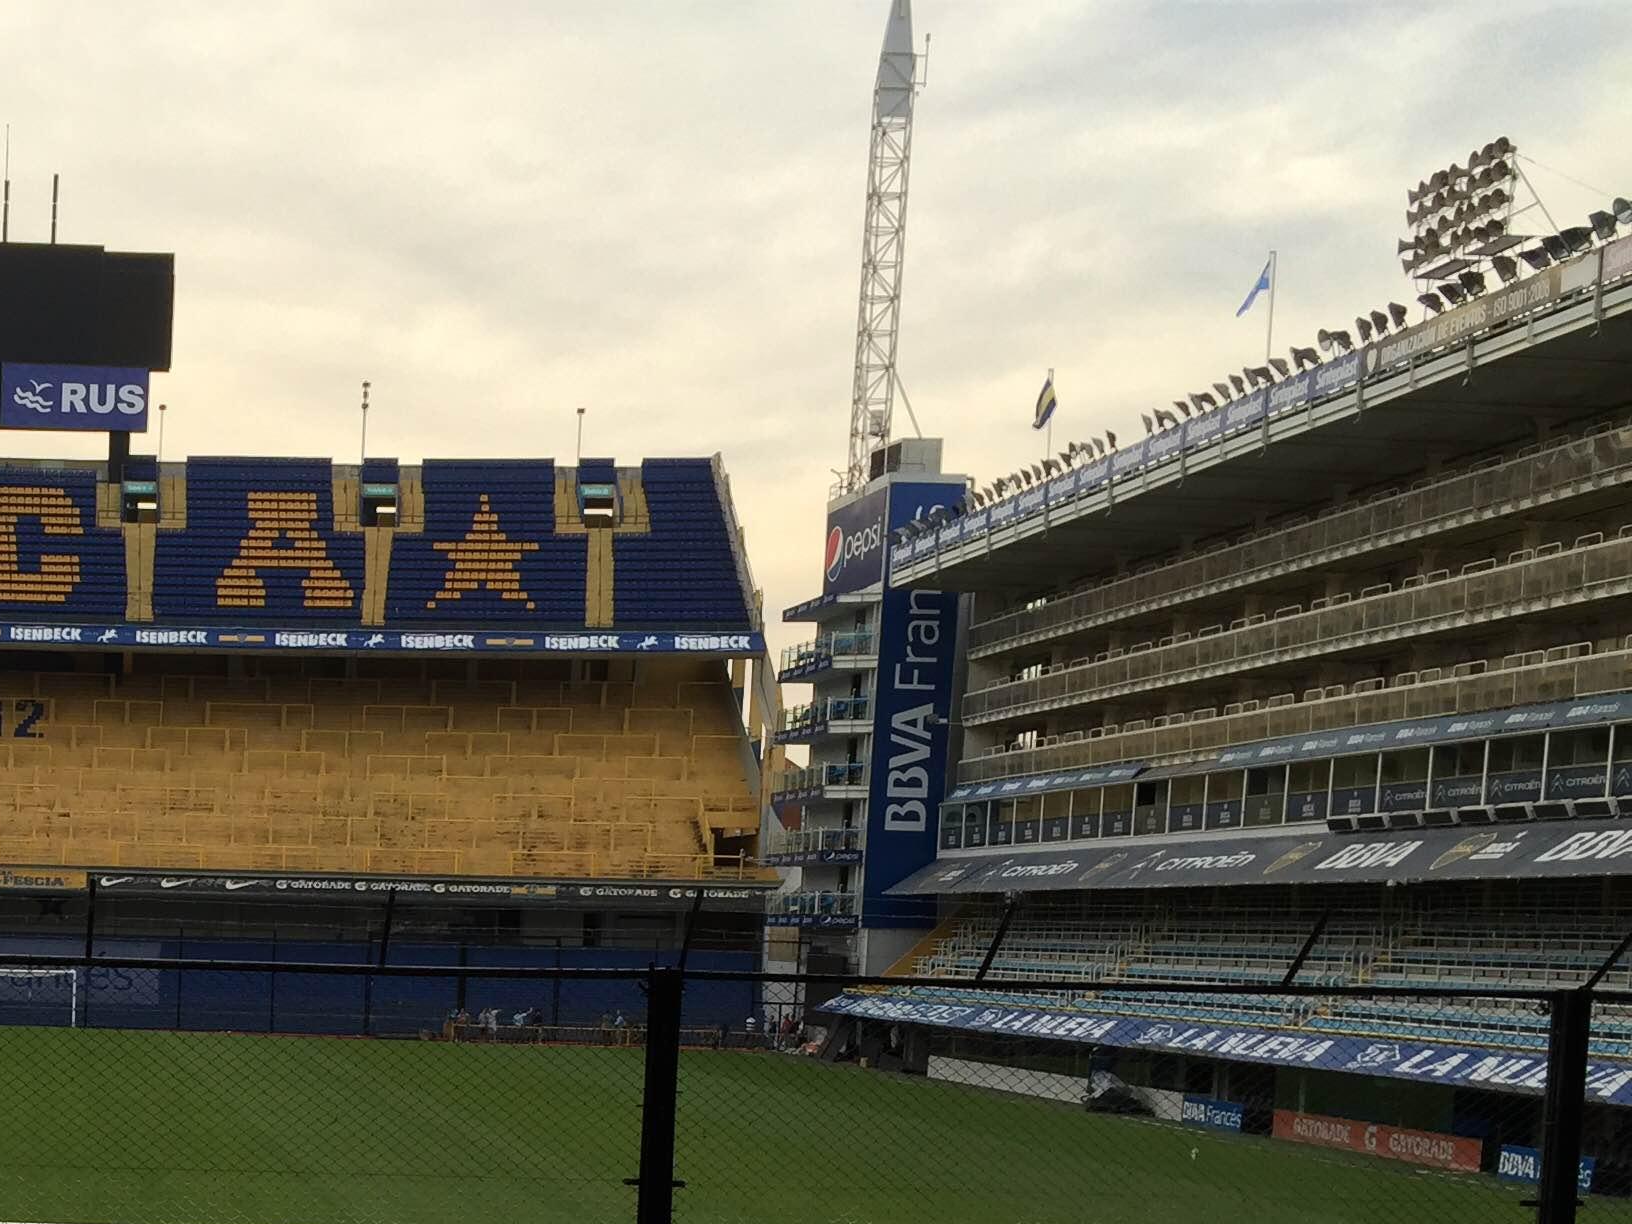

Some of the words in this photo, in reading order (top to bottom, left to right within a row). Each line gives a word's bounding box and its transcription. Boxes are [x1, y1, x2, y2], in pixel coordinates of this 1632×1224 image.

[61, 382, 145, 415] RUS
[843, 515, 882, 568] pepsi
[10, 626, 82, 641] ISENBECK
[135, 630, 208, 645] ISENBECK
[275, 632, 348, 648] ISENBECK
[400, 634, 475, 649] ISENBECK
[544, 635, 620, 650] ISENBECK
[674, 635, 751, 650] ISENBECK
[885, 702, 936, 832] BBVA
[1314, 841, 1424, 870] BBVA
[449, 883, 510, 894] GATORADE
[1022, 1014, 1118, 1039] NUEVA
[1168, 1028, 1221, 1050] LA
[1209, 1032, 1335, 1062] NUEVA
[1393, 1049, 1468, 1077] LA
[1206, 1104, 1242, 1128] Francés
[1293, 1117, 1351, 1144] GATORADE
[1389, 1132, 1456, 1160] GATORADE
[1498, 1151, 1535, 1178] BBVA
